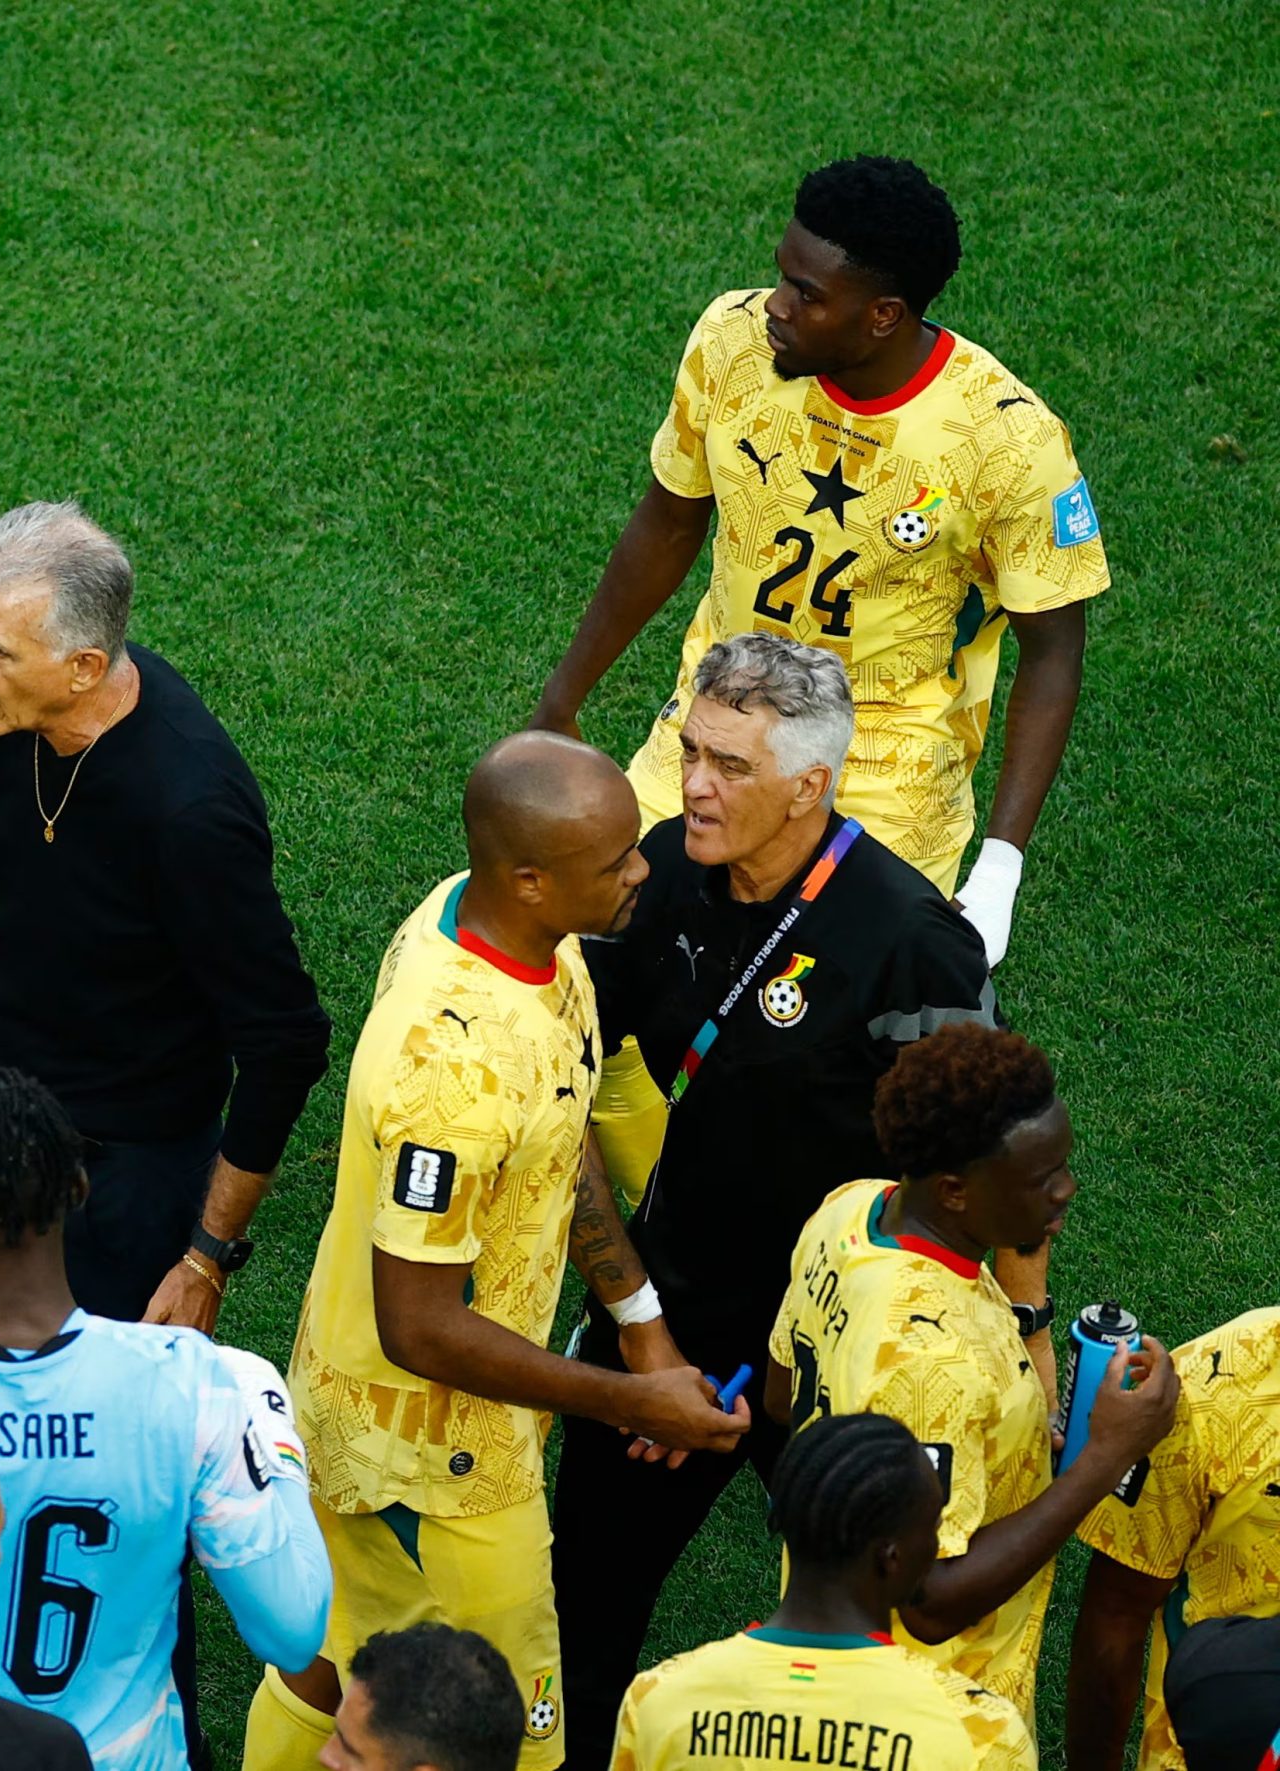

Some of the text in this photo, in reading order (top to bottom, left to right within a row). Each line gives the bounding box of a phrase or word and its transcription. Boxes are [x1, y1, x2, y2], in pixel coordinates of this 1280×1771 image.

[807, 413, 881, 447] CROATIA VS GHANA
[820, 434, 838, 446] June
[848, 446, 866, 457] 2026
[754, 526, 860, 637] 24
[718, 907, 800, 1016] FIFA WORLD CUP 2026
[688, 1710, 913, 1771] KAMALDEEN
